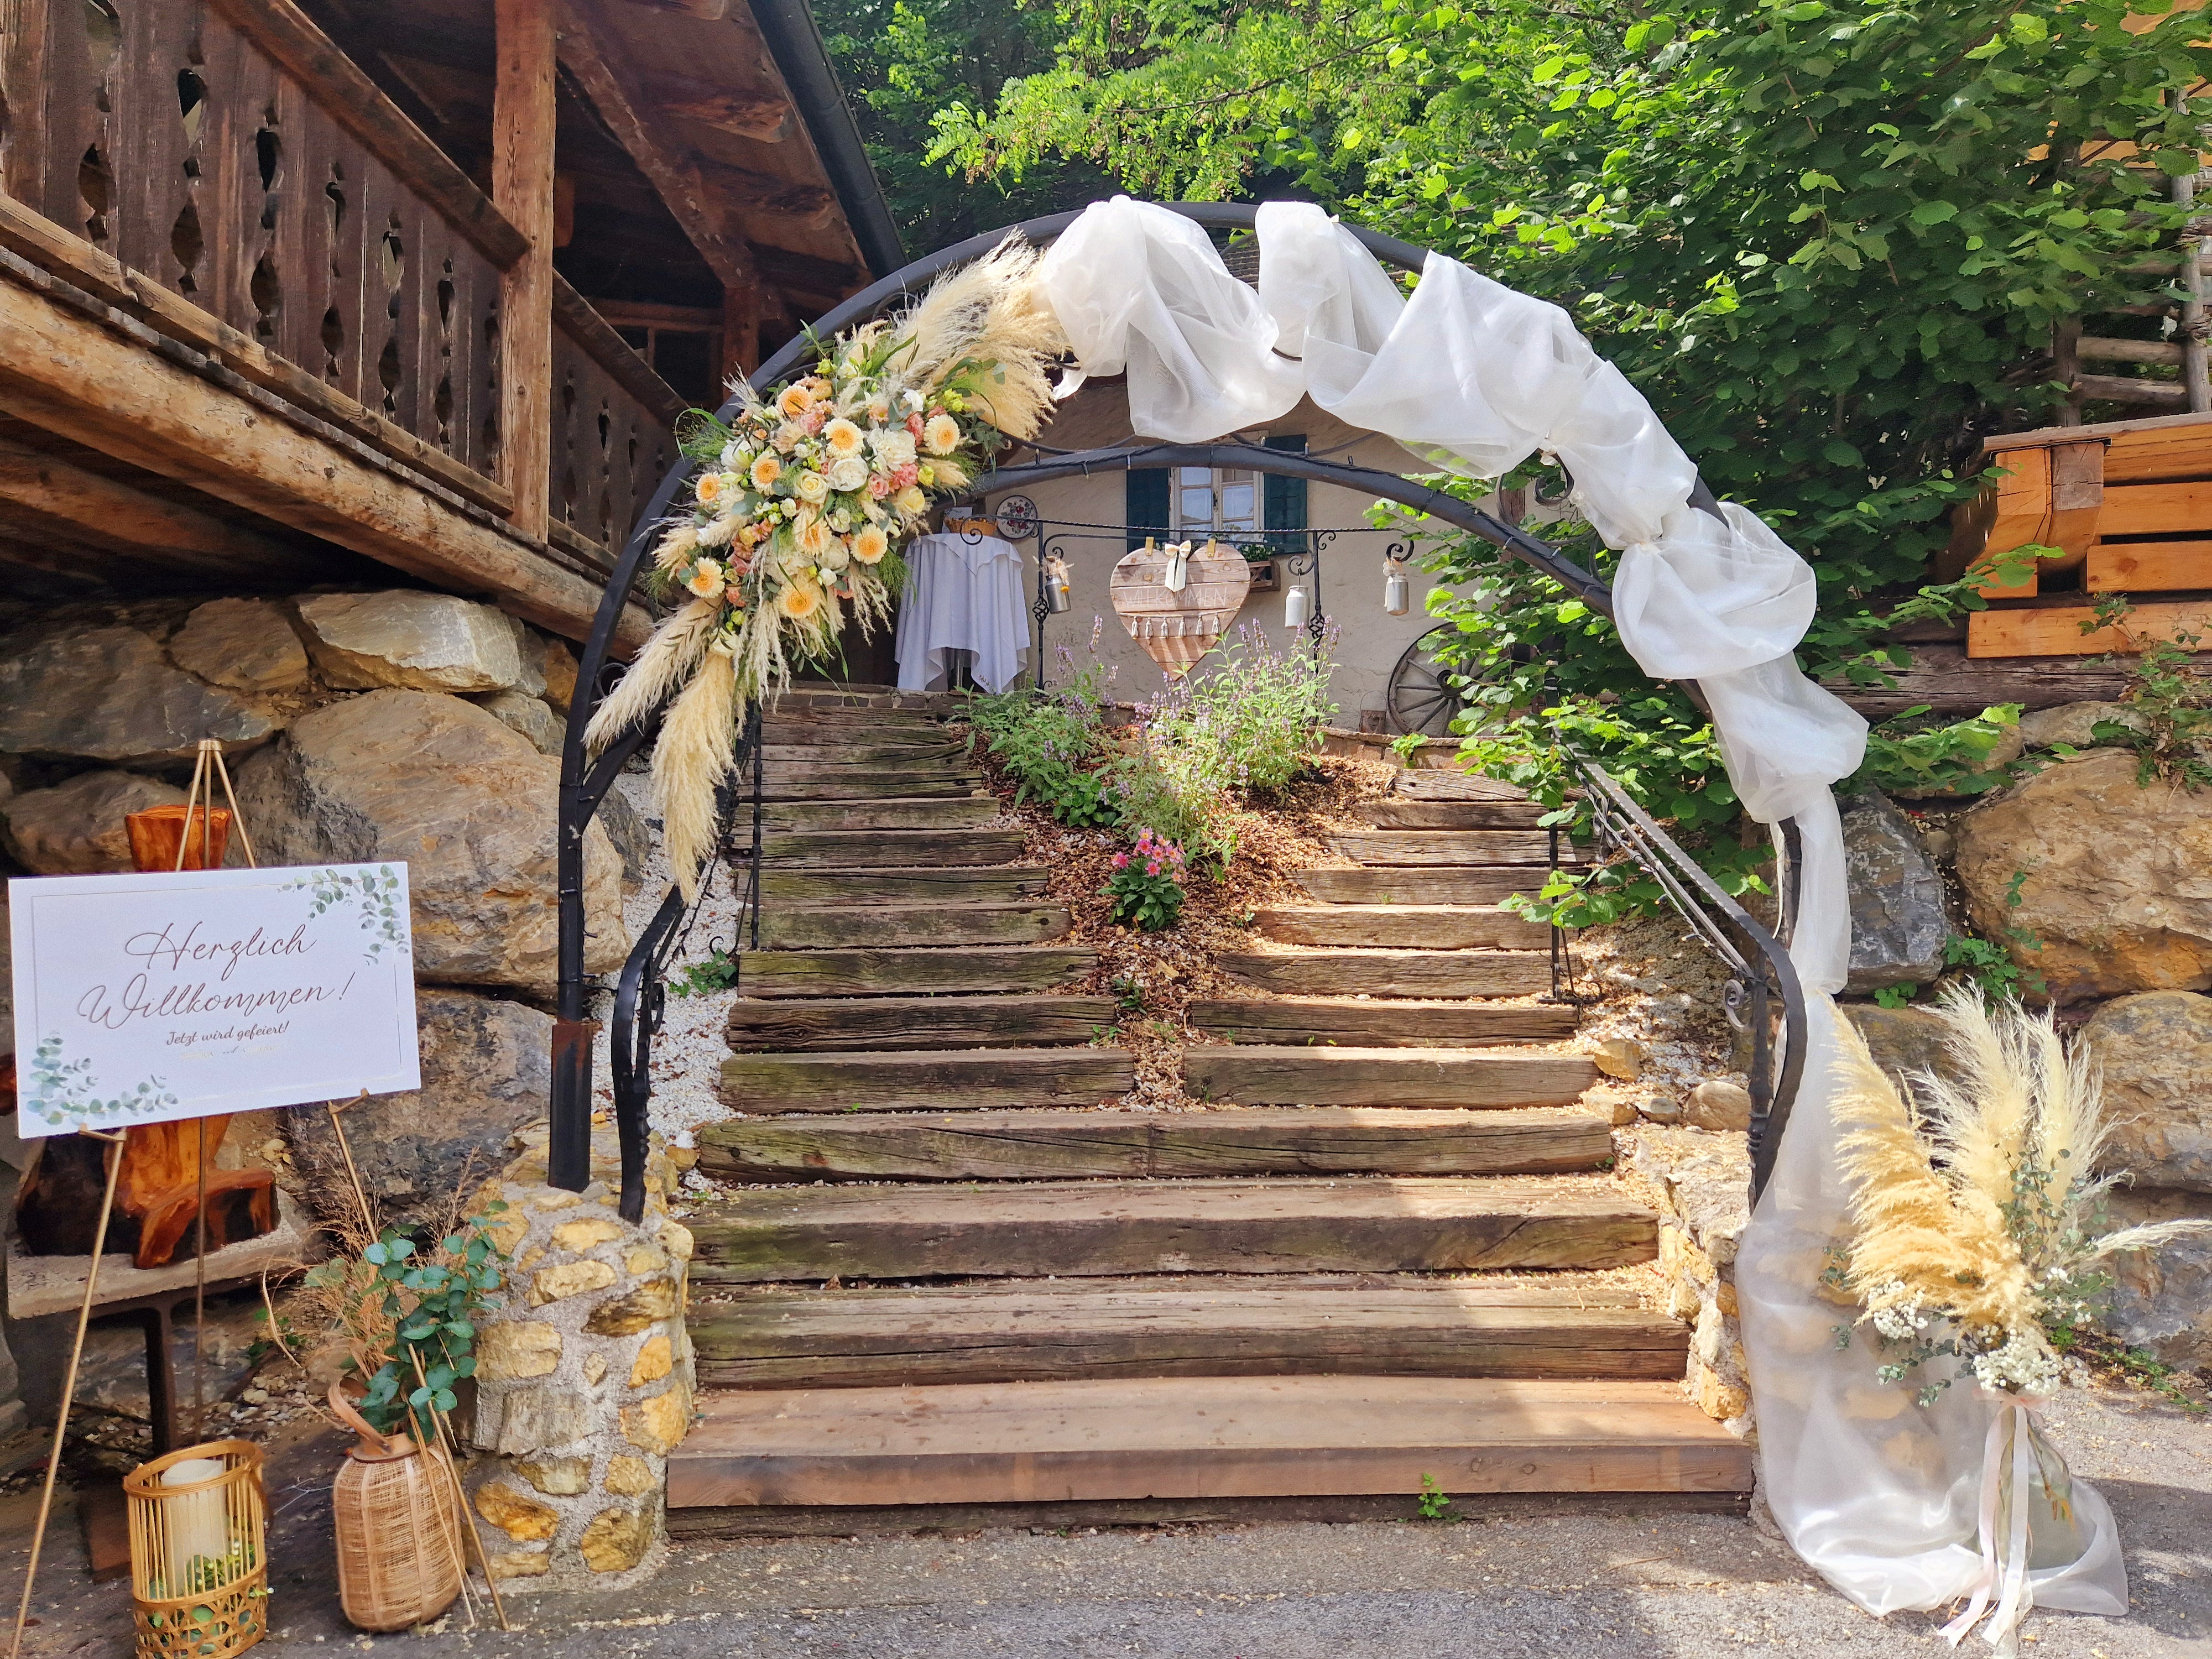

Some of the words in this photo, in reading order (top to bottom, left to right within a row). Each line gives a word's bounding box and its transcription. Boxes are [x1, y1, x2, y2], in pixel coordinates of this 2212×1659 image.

[1123, 586, 1227, 608] WILLKOMMEN
[124, 921, 317, 982] Herzlich
[166, 1031, 199, 1046] Jetzt
[202, 1026, 234, 1041] wird
[237, 1020, 290, 1041] gefeiert!
